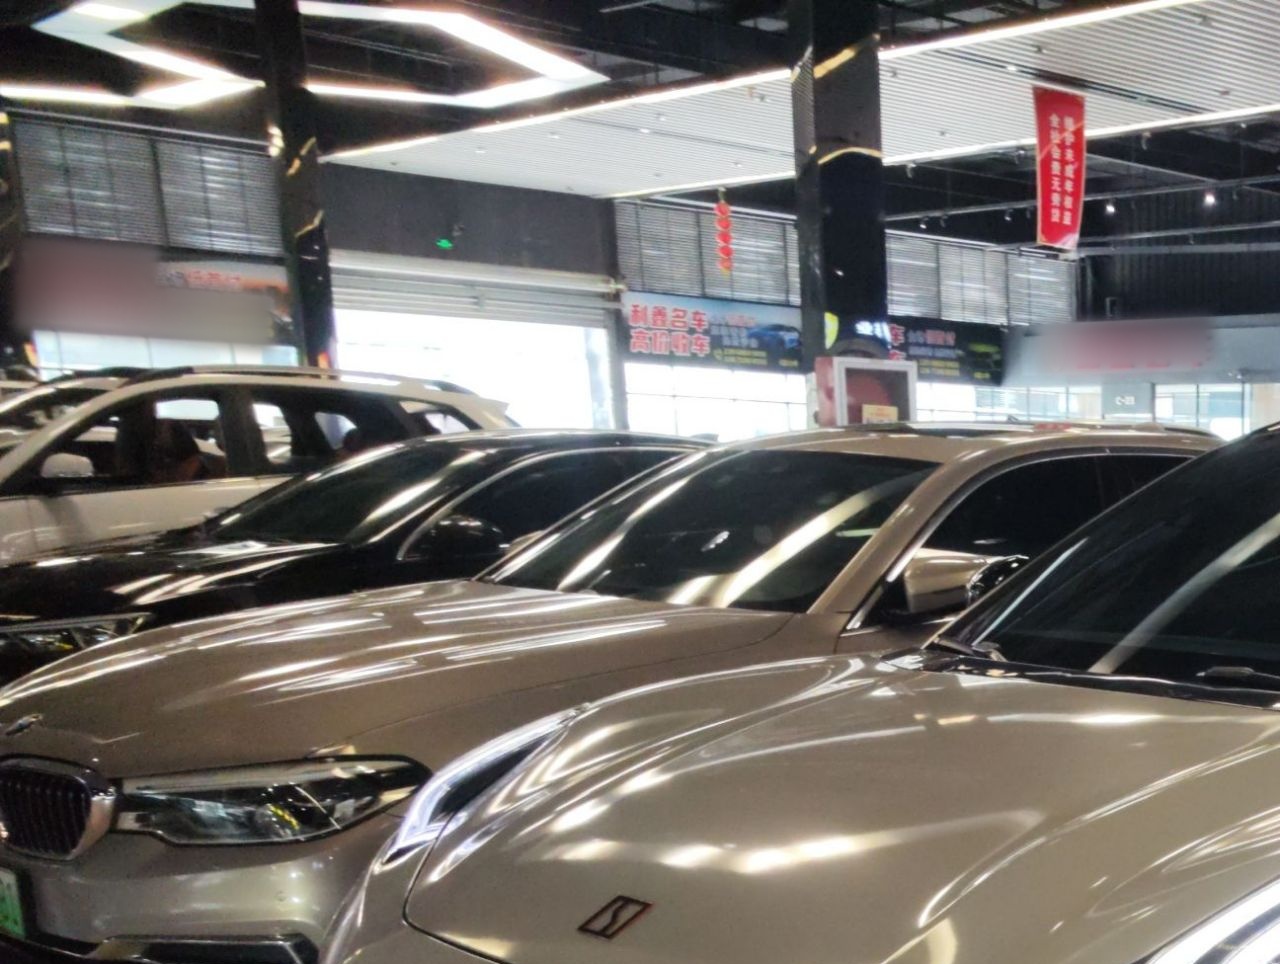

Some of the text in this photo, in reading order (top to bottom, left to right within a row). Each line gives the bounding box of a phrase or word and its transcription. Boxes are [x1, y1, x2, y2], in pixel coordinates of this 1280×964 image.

[628, 303, 709, 333] 利鑫名车
[629, 328, 711, 357] 高价收车
